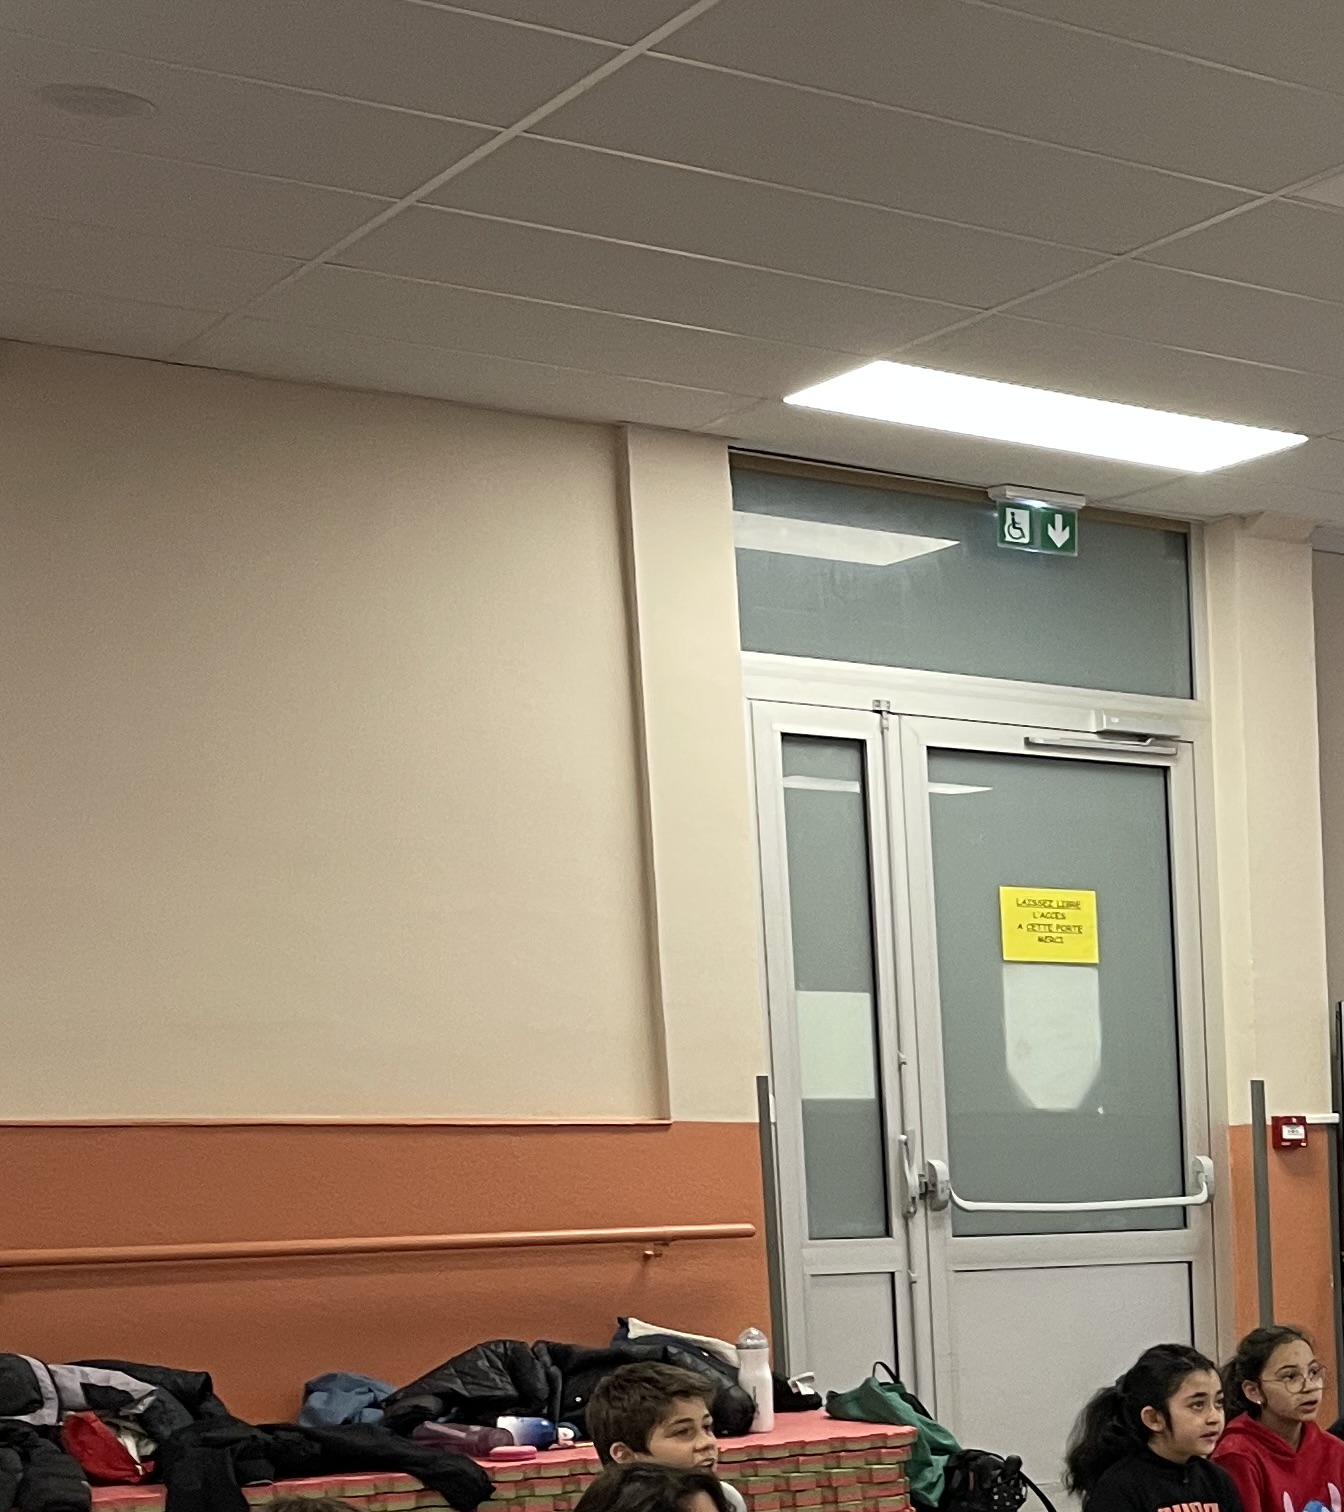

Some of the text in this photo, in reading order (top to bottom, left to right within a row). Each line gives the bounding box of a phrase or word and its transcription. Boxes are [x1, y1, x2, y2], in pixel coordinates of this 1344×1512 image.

[1016, 898, 1081, 909] LAISSEZ LIBRE
[1026, 923, 1053, 932] CETTE
[1056, 924, 1083, 933] PORTE
[1037, 936, 1064, 944] MERCI
